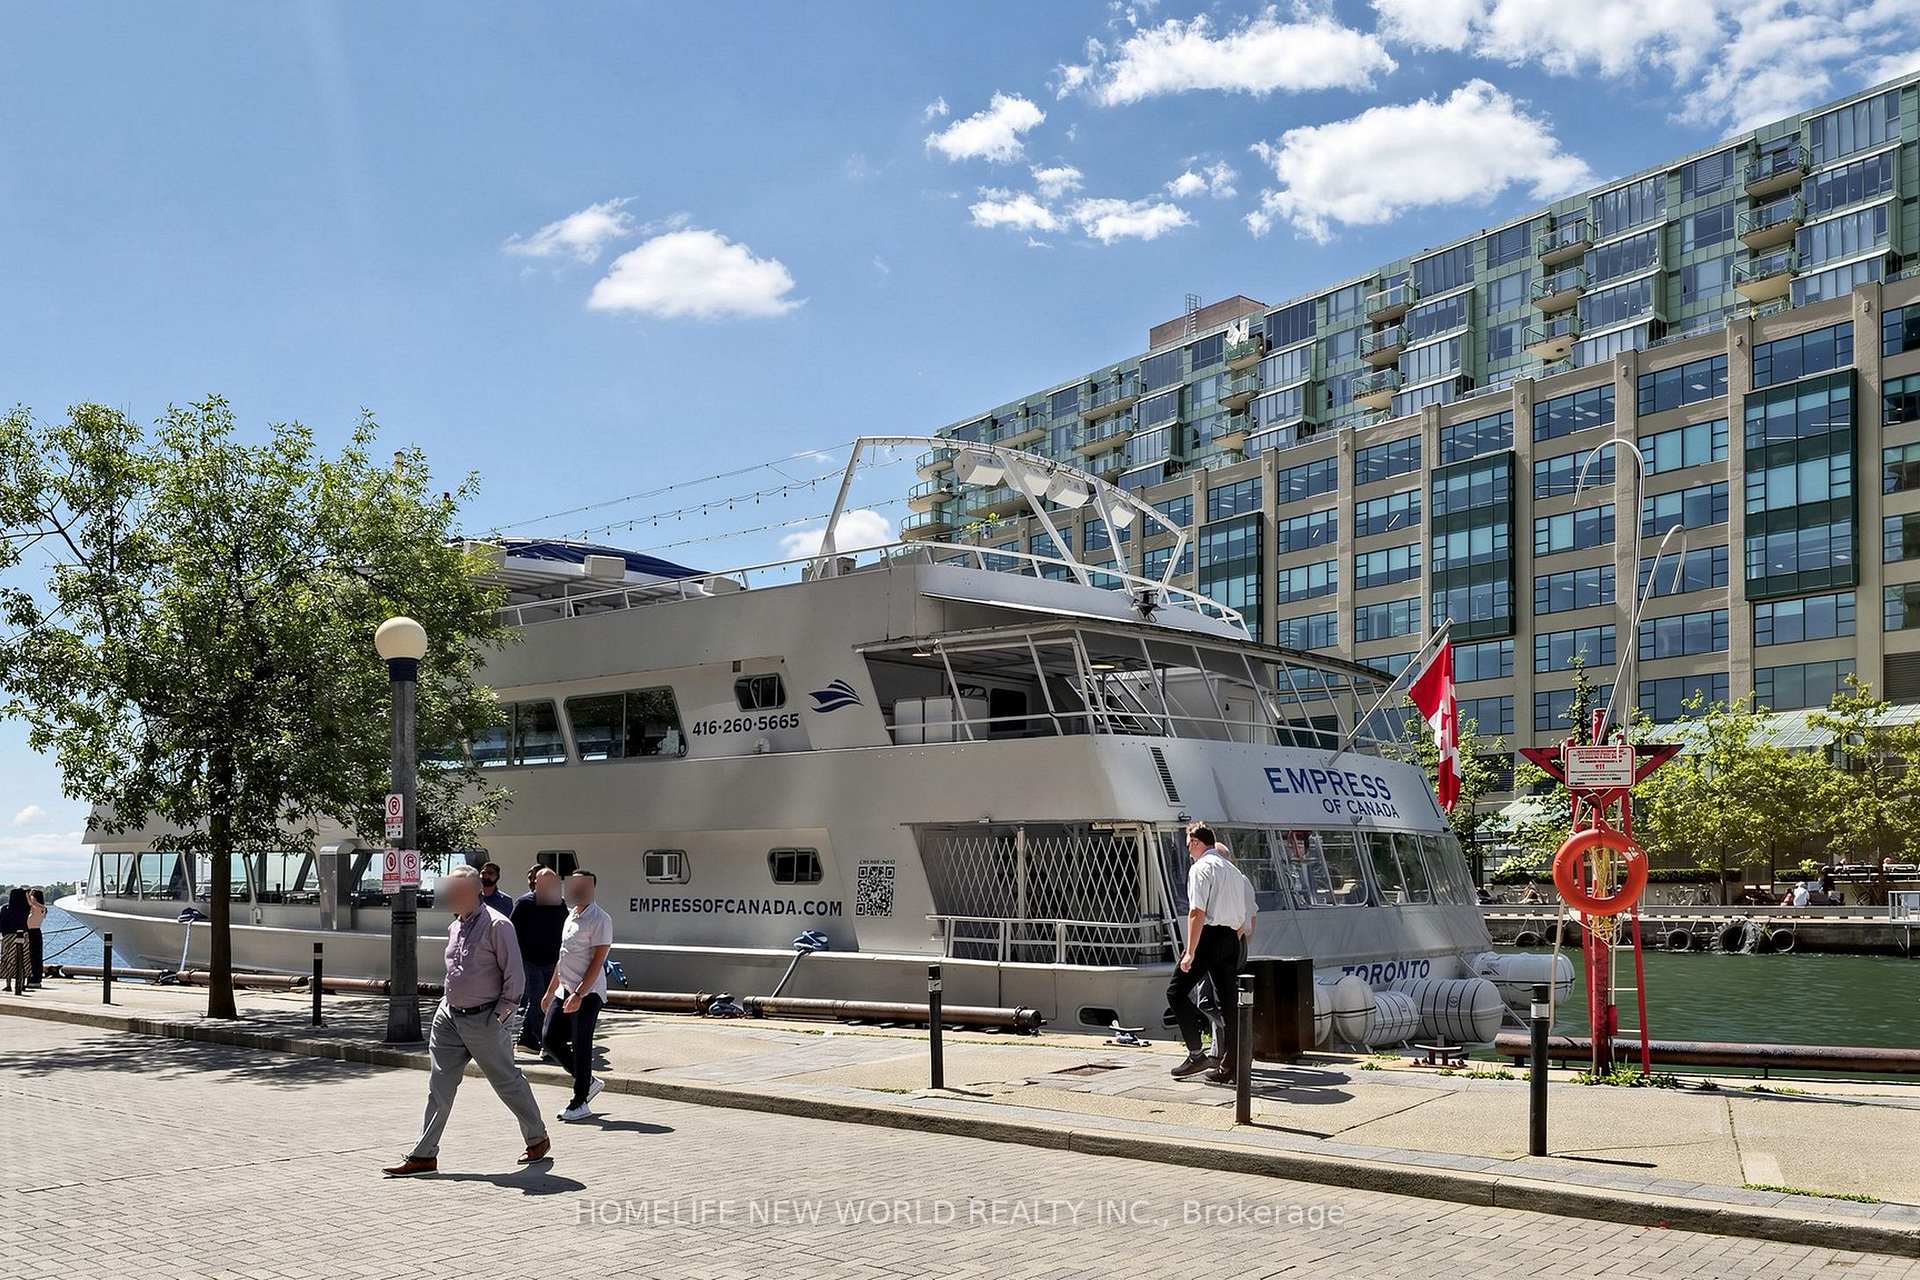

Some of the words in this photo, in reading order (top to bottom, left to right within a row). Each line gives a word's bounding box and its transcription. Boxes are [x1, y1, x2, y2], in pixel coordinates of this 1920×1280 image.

[1264, 767, 1392, 801] EMPRESS
[1323, 798, 1341, 814] OF
[1347, 800, 1400, 819] CANADA
[629, 898, 843, 917] EMPRESSOFCANADA.COM
